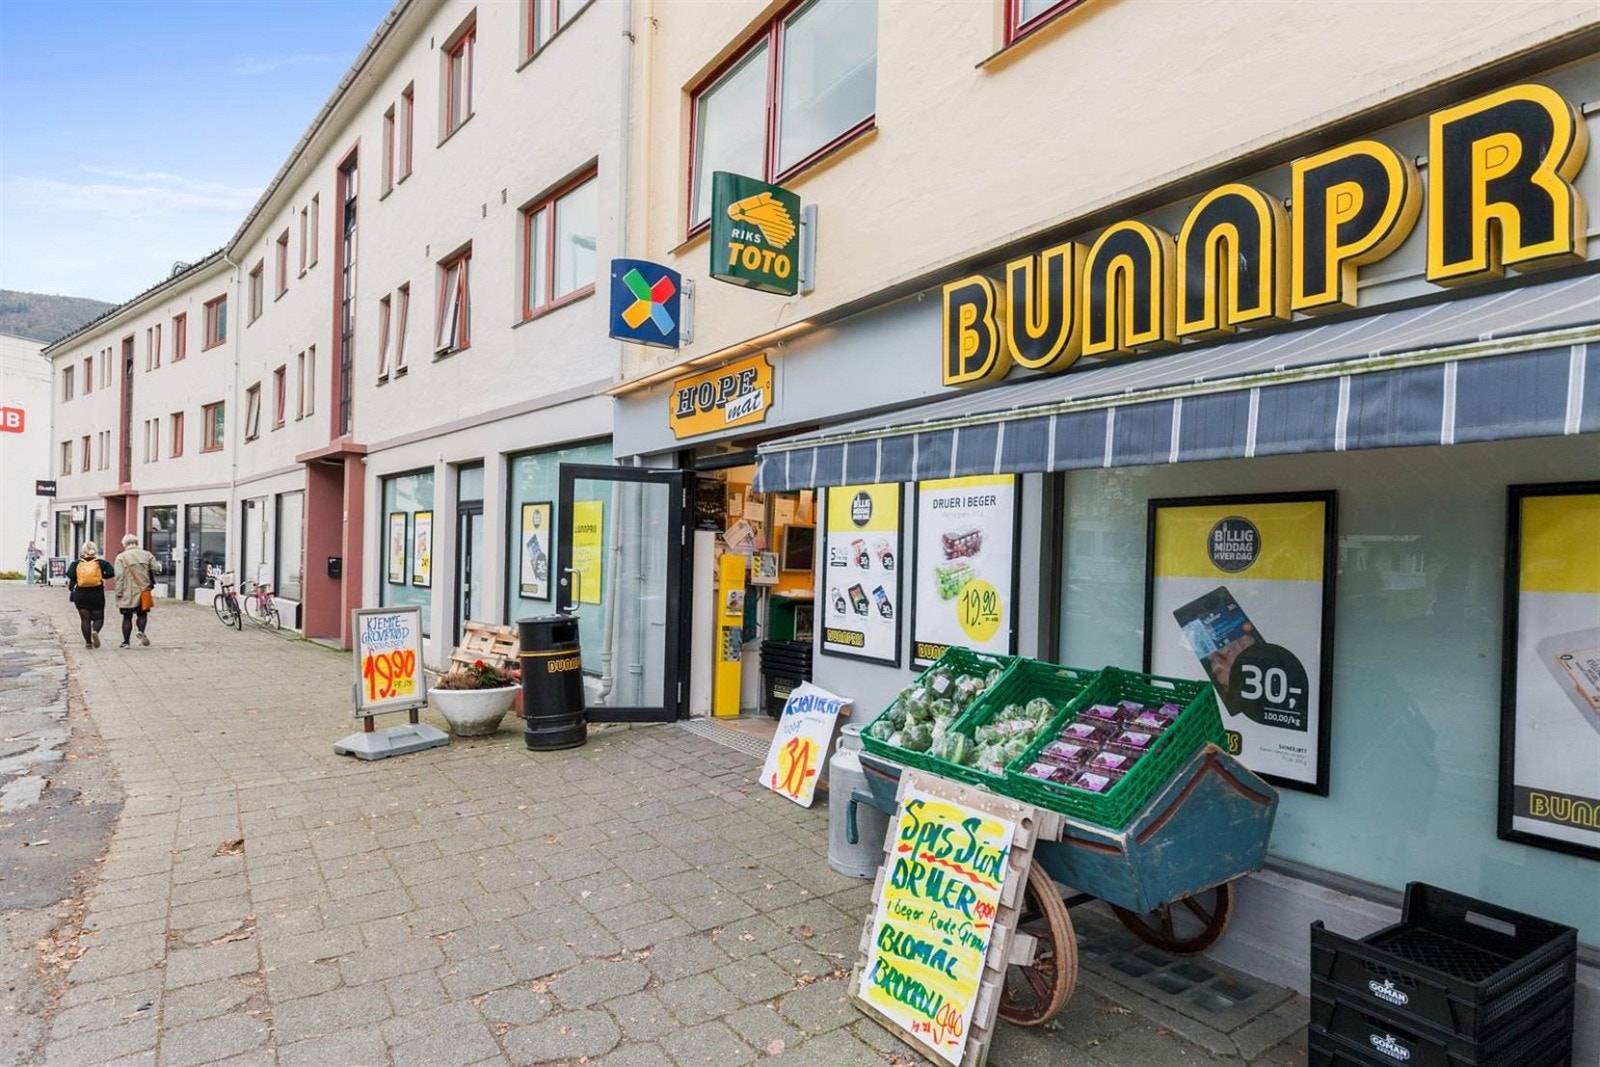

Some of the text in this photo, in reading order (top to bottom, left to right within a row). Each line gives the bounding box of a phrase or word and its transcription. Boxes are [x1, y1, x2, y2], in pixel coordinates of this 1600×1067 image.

[732, 228, 761, 243] RIKS
[728, 242, 791, 278] TOTO
[676, 367, 757, 419] HOPE
[727, 390, 761, 420] mat
[933, 495, 996, 509] DRUER I BEGER
[1214, 526, 1254, 542] BILLIG
[831, 547, 836, 561] 5
[1214, 542, 1253, 552] MIDDAG
[1264, 712, 1300, 727] 100,00/kg
[901, 799, 955, 862] Spis
[1370, 982, 1406, 1003] GOMAN
[1372, 1036, 1408, 1057] GOMAN
